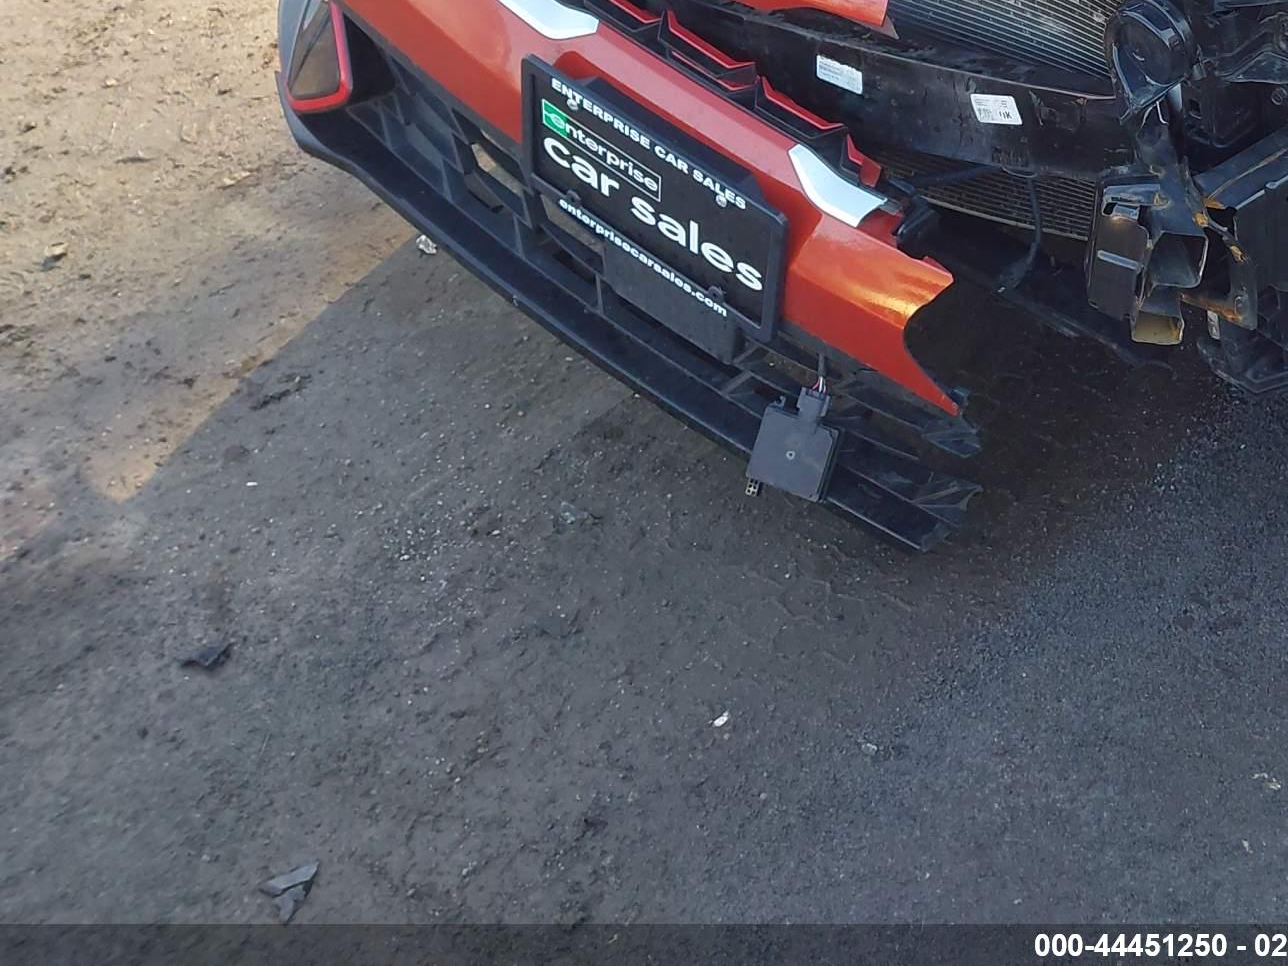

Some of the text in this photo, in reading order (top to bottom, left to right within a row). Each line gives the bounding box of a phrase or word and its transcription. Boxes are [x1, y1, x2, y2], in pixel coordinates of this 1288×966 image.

[549, 113, 658, 192] enterprise
[551, 77, 746, 210] ENTERPRISE CAR SALES
[543, 137, 763, 291] car sales
[558, 198, 728, 317] enterprisecarsales.com
